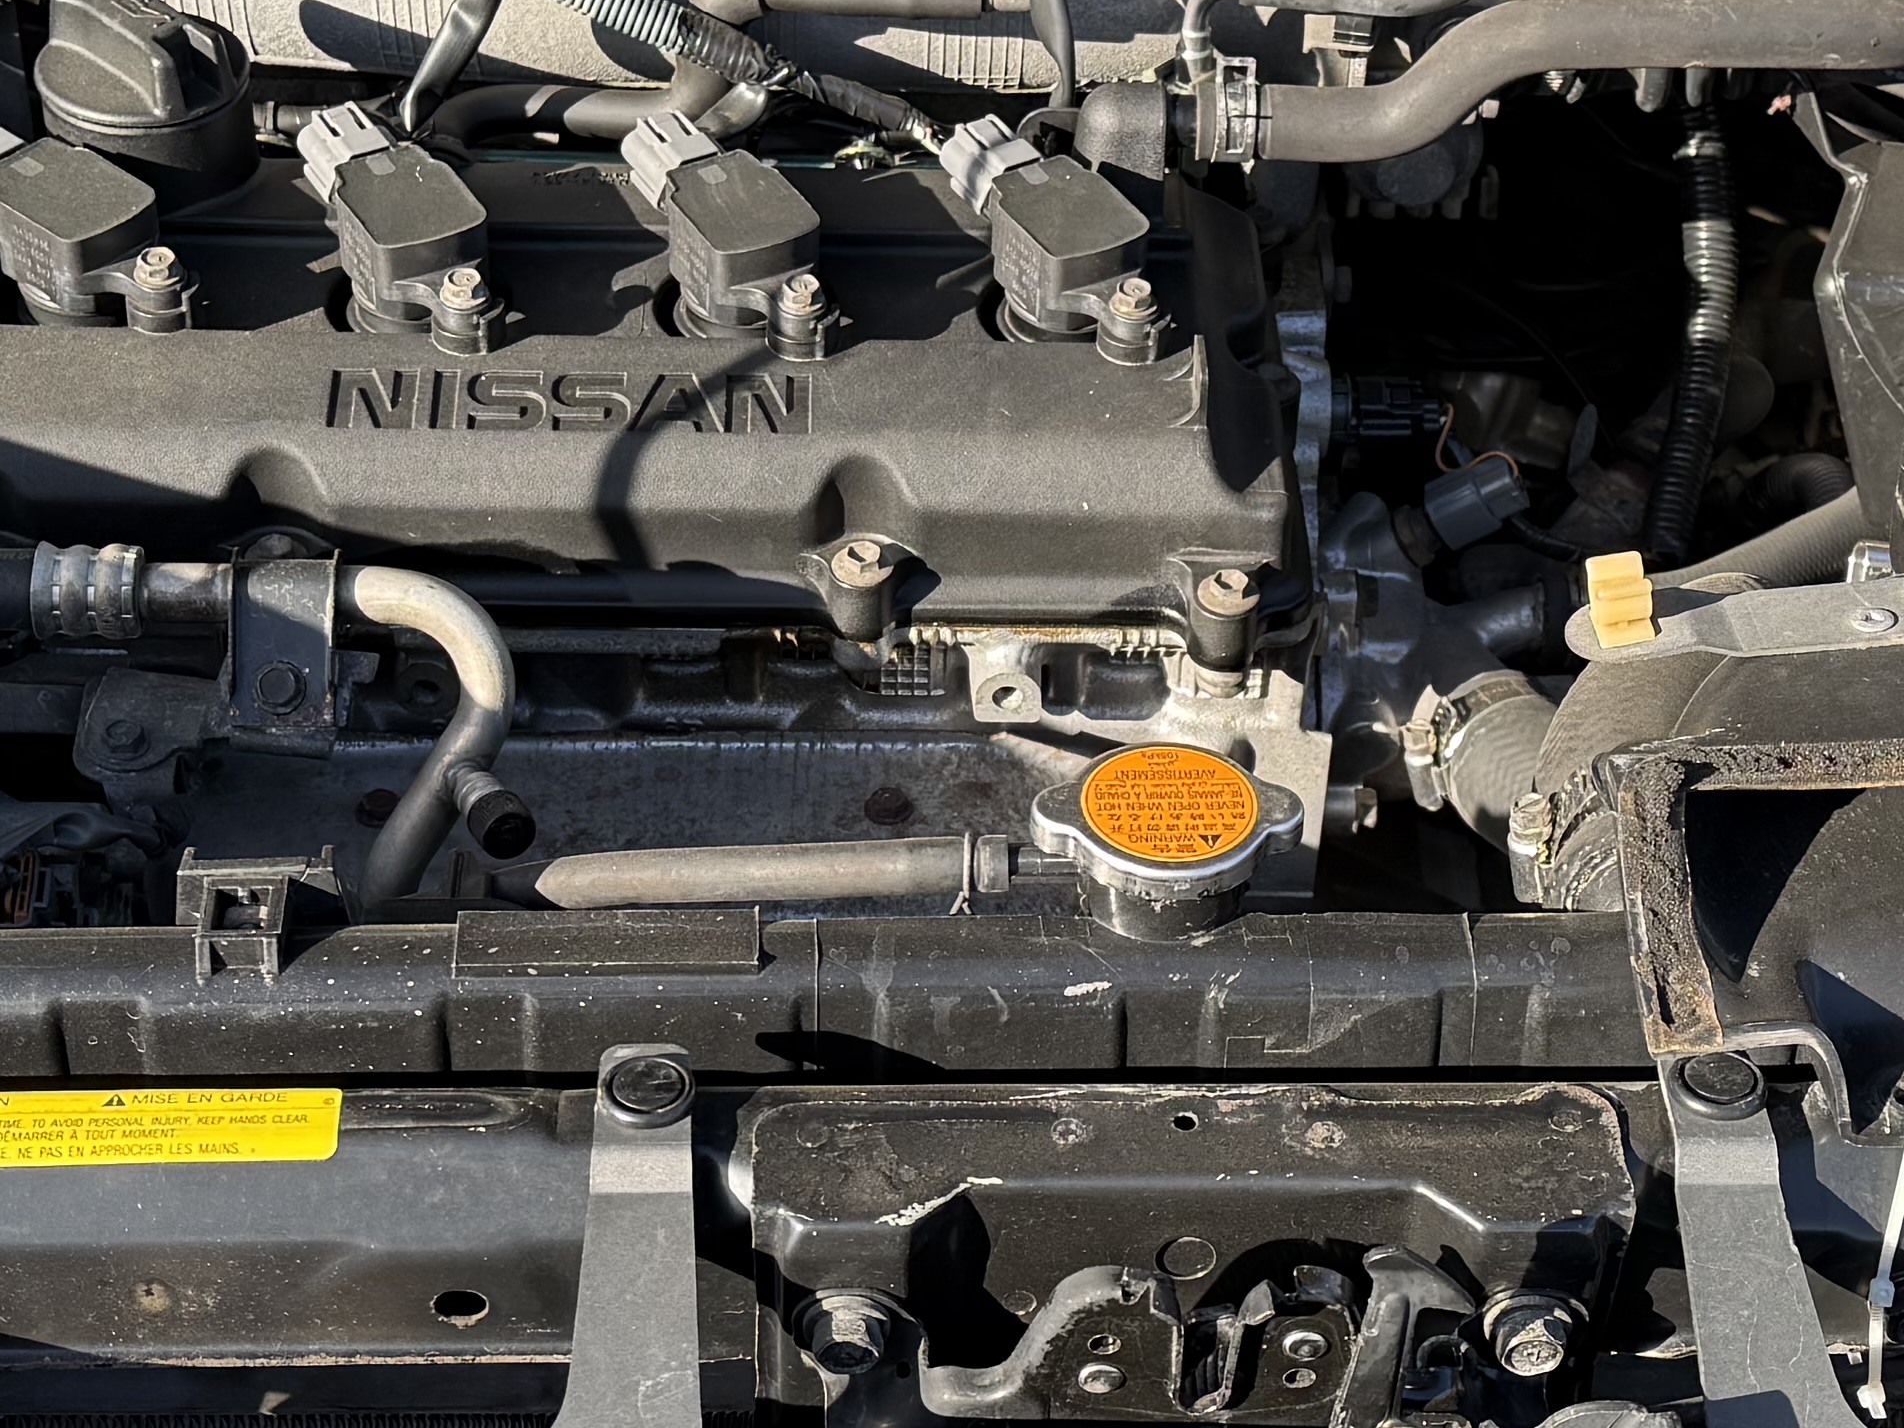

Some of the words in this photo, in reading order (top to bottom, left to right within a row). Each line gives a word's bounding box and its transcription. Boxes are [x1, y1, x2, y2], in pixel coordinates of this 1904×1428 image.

[326, 367, 813, 433] NISSAN
[1113, 769, 1216, 780] AVERTISSEMENT
[1125, 801, 1162, 811] WHEN
[1167, 801, 1201, 811] OPEN
[1205, 800, 1245, 811] NEVER
[1127, 833, 1196, 843] WARNING
[131, 1093, 180, 1105] MISE
[186, 1093, 214, 1104] EN
[220, 1092, 289, 1103] GARDE
[31, 1118, 46, 1129] TO
[50, 1117, 84, 1129] AVOID
[88, 1115, 145, 1128] PERSONAL
[197, 1114, 225, 1126] KEEP
[229, 1114, 268, 1126] HANDS
[85, 1128, 116, 1141] TOUT
[17, 1146, 33, 1159] NE
[39, 1146, 63, 1157] PAS
[68, 1145, 85, 1158] EN
[90, 1143, 164, 1157] APPROCHER
[169, 1143, 194, 1156] LES
